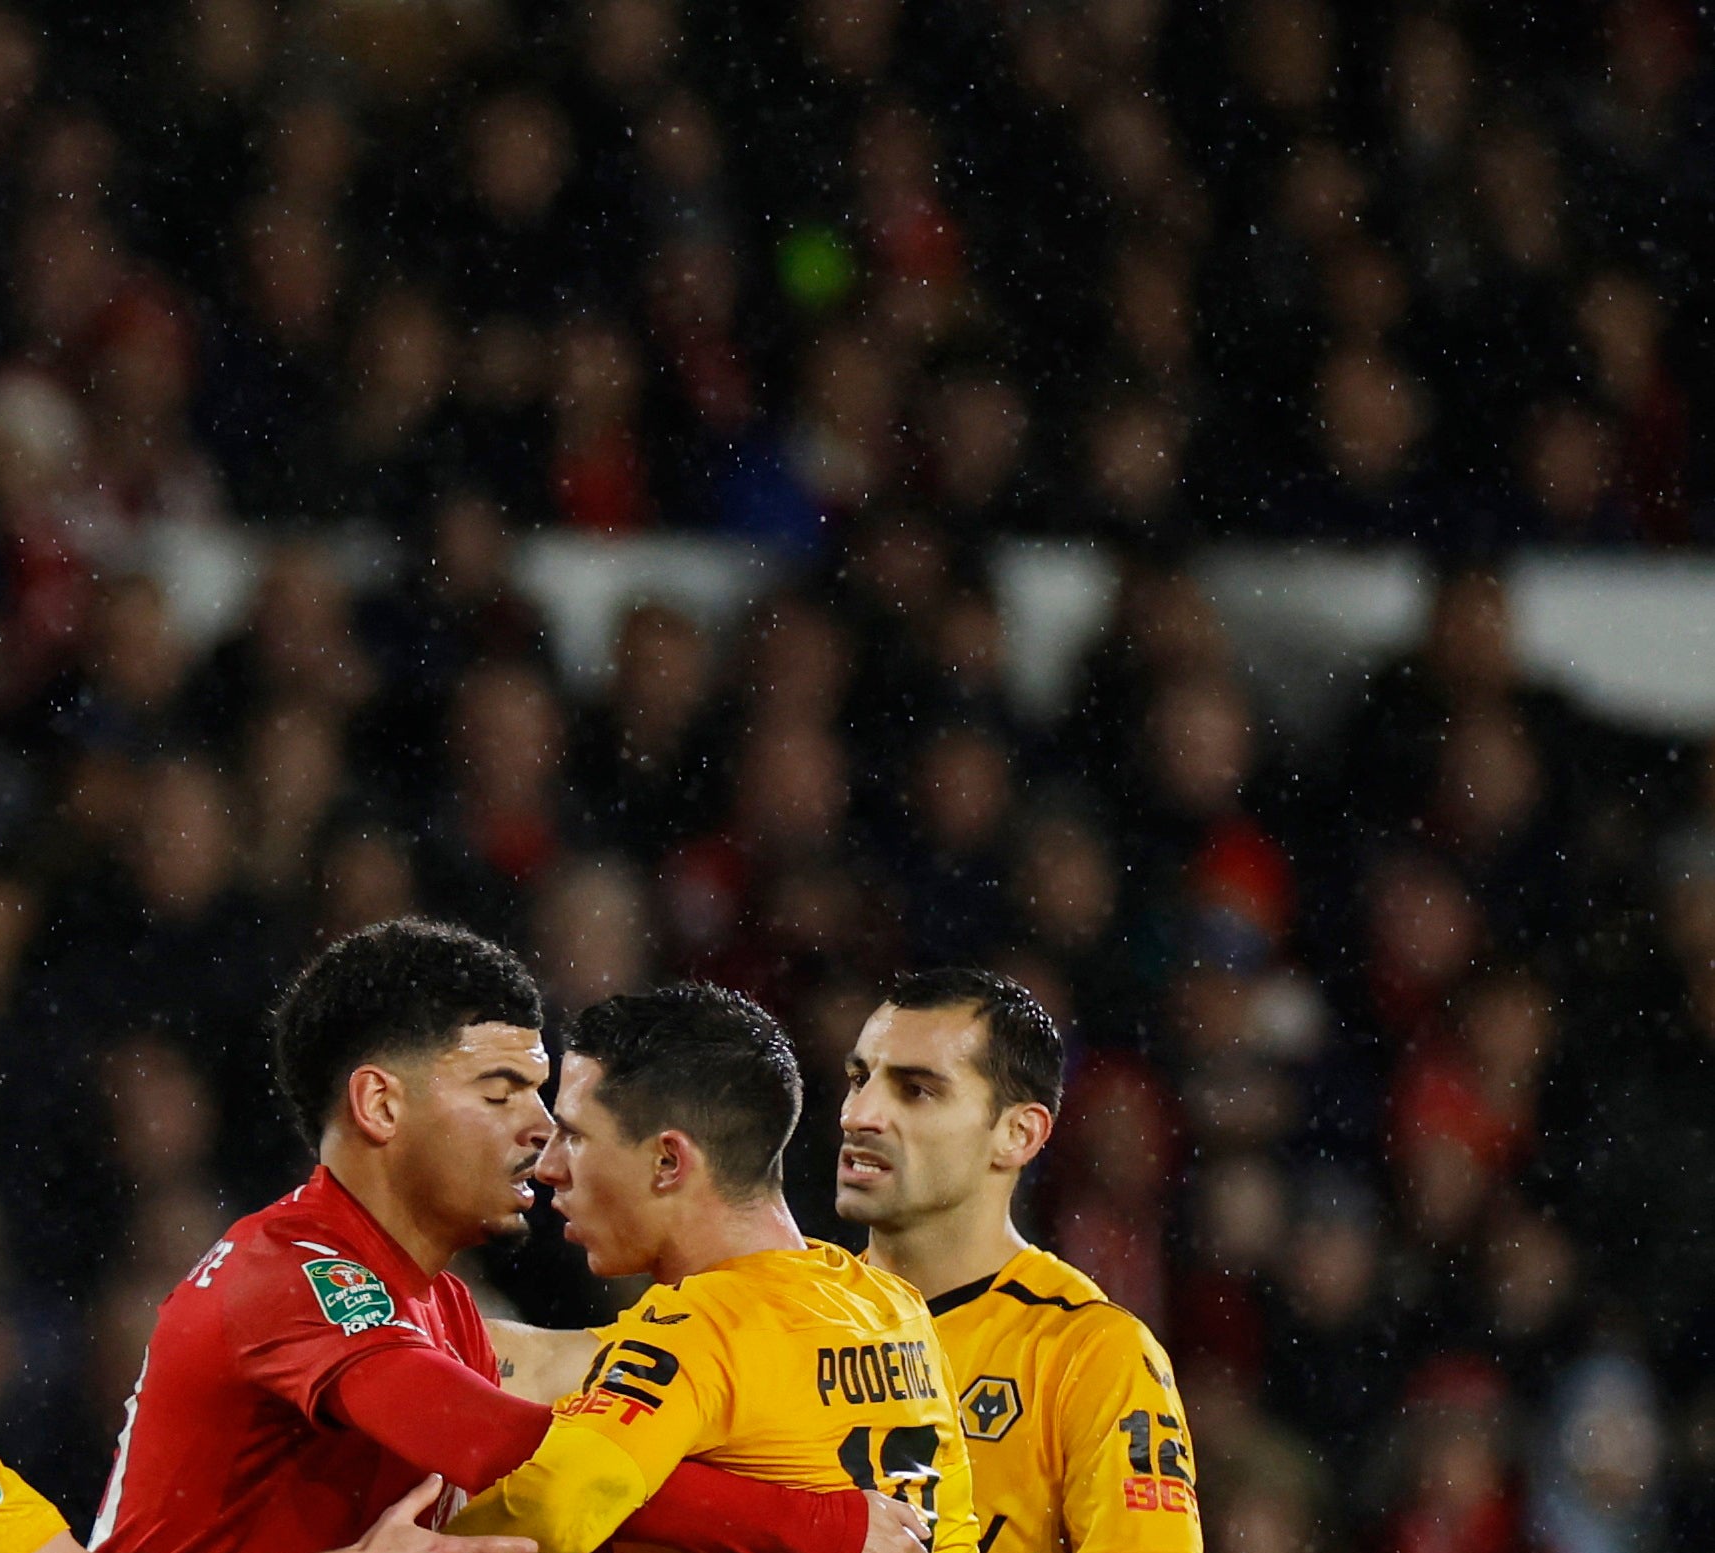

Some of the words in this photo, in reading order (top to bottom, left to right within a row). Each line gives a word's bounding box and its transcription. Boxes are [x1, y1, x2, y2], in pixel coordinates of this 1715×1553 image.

[325, 1283, 381, 1308] Carabao
[344, 1293, 372, 1310] Cup
[582, 1339, 680, 1409] 12
[817, 1341, 938, 1407] PODENCE
[1119, 1409, 1194, 1487] 12
